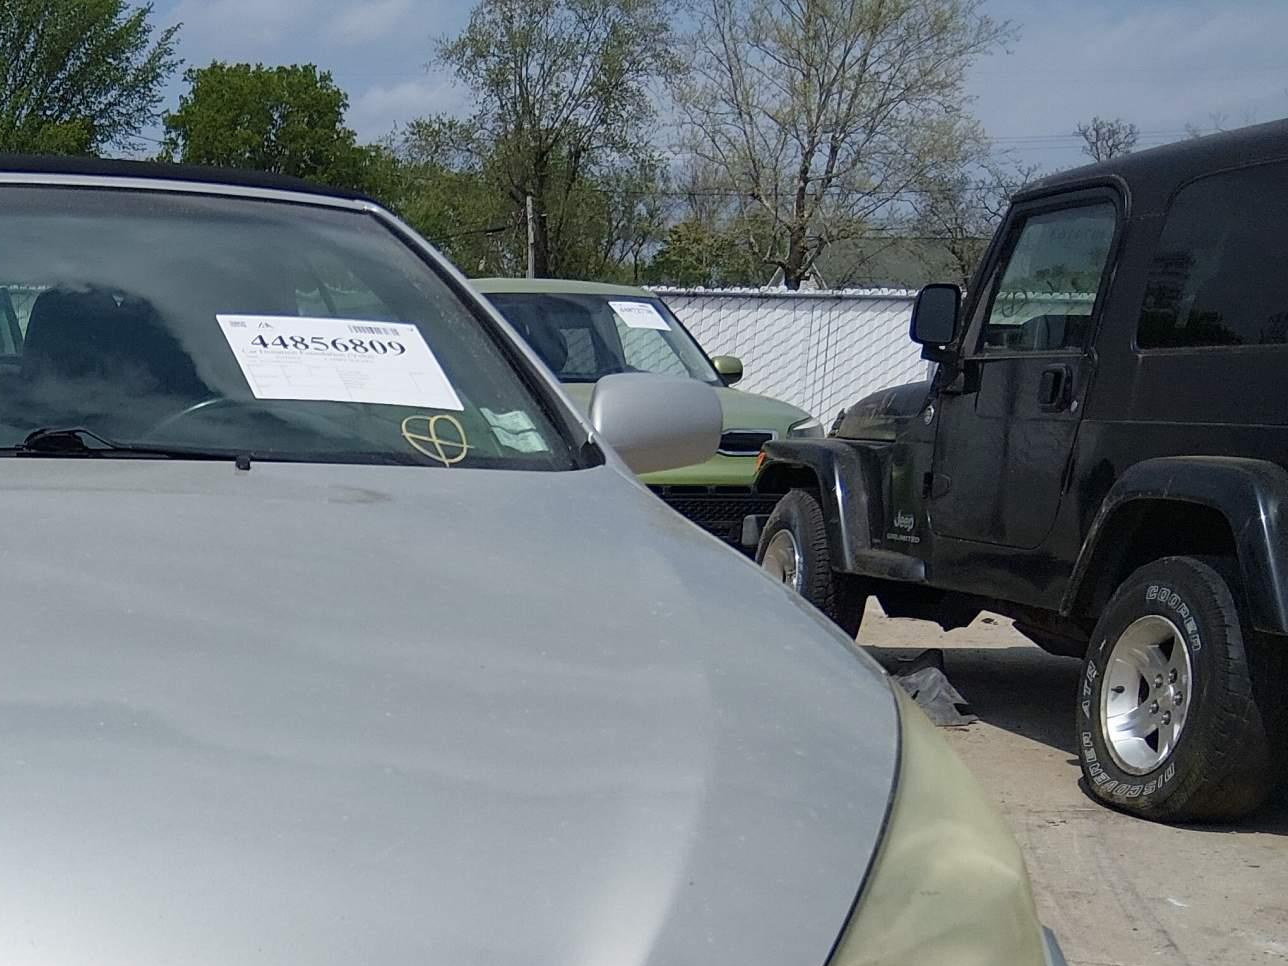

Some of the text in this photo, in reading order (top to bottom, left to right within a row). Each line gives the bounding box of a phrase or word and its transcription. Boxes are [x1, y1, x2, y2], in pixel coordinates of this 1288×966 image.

[250, 333, 407, 357] 44856809
[1146, 585, 1202, 652] COOPER
[1082, 731, 1176, 799] DISCOVERER
